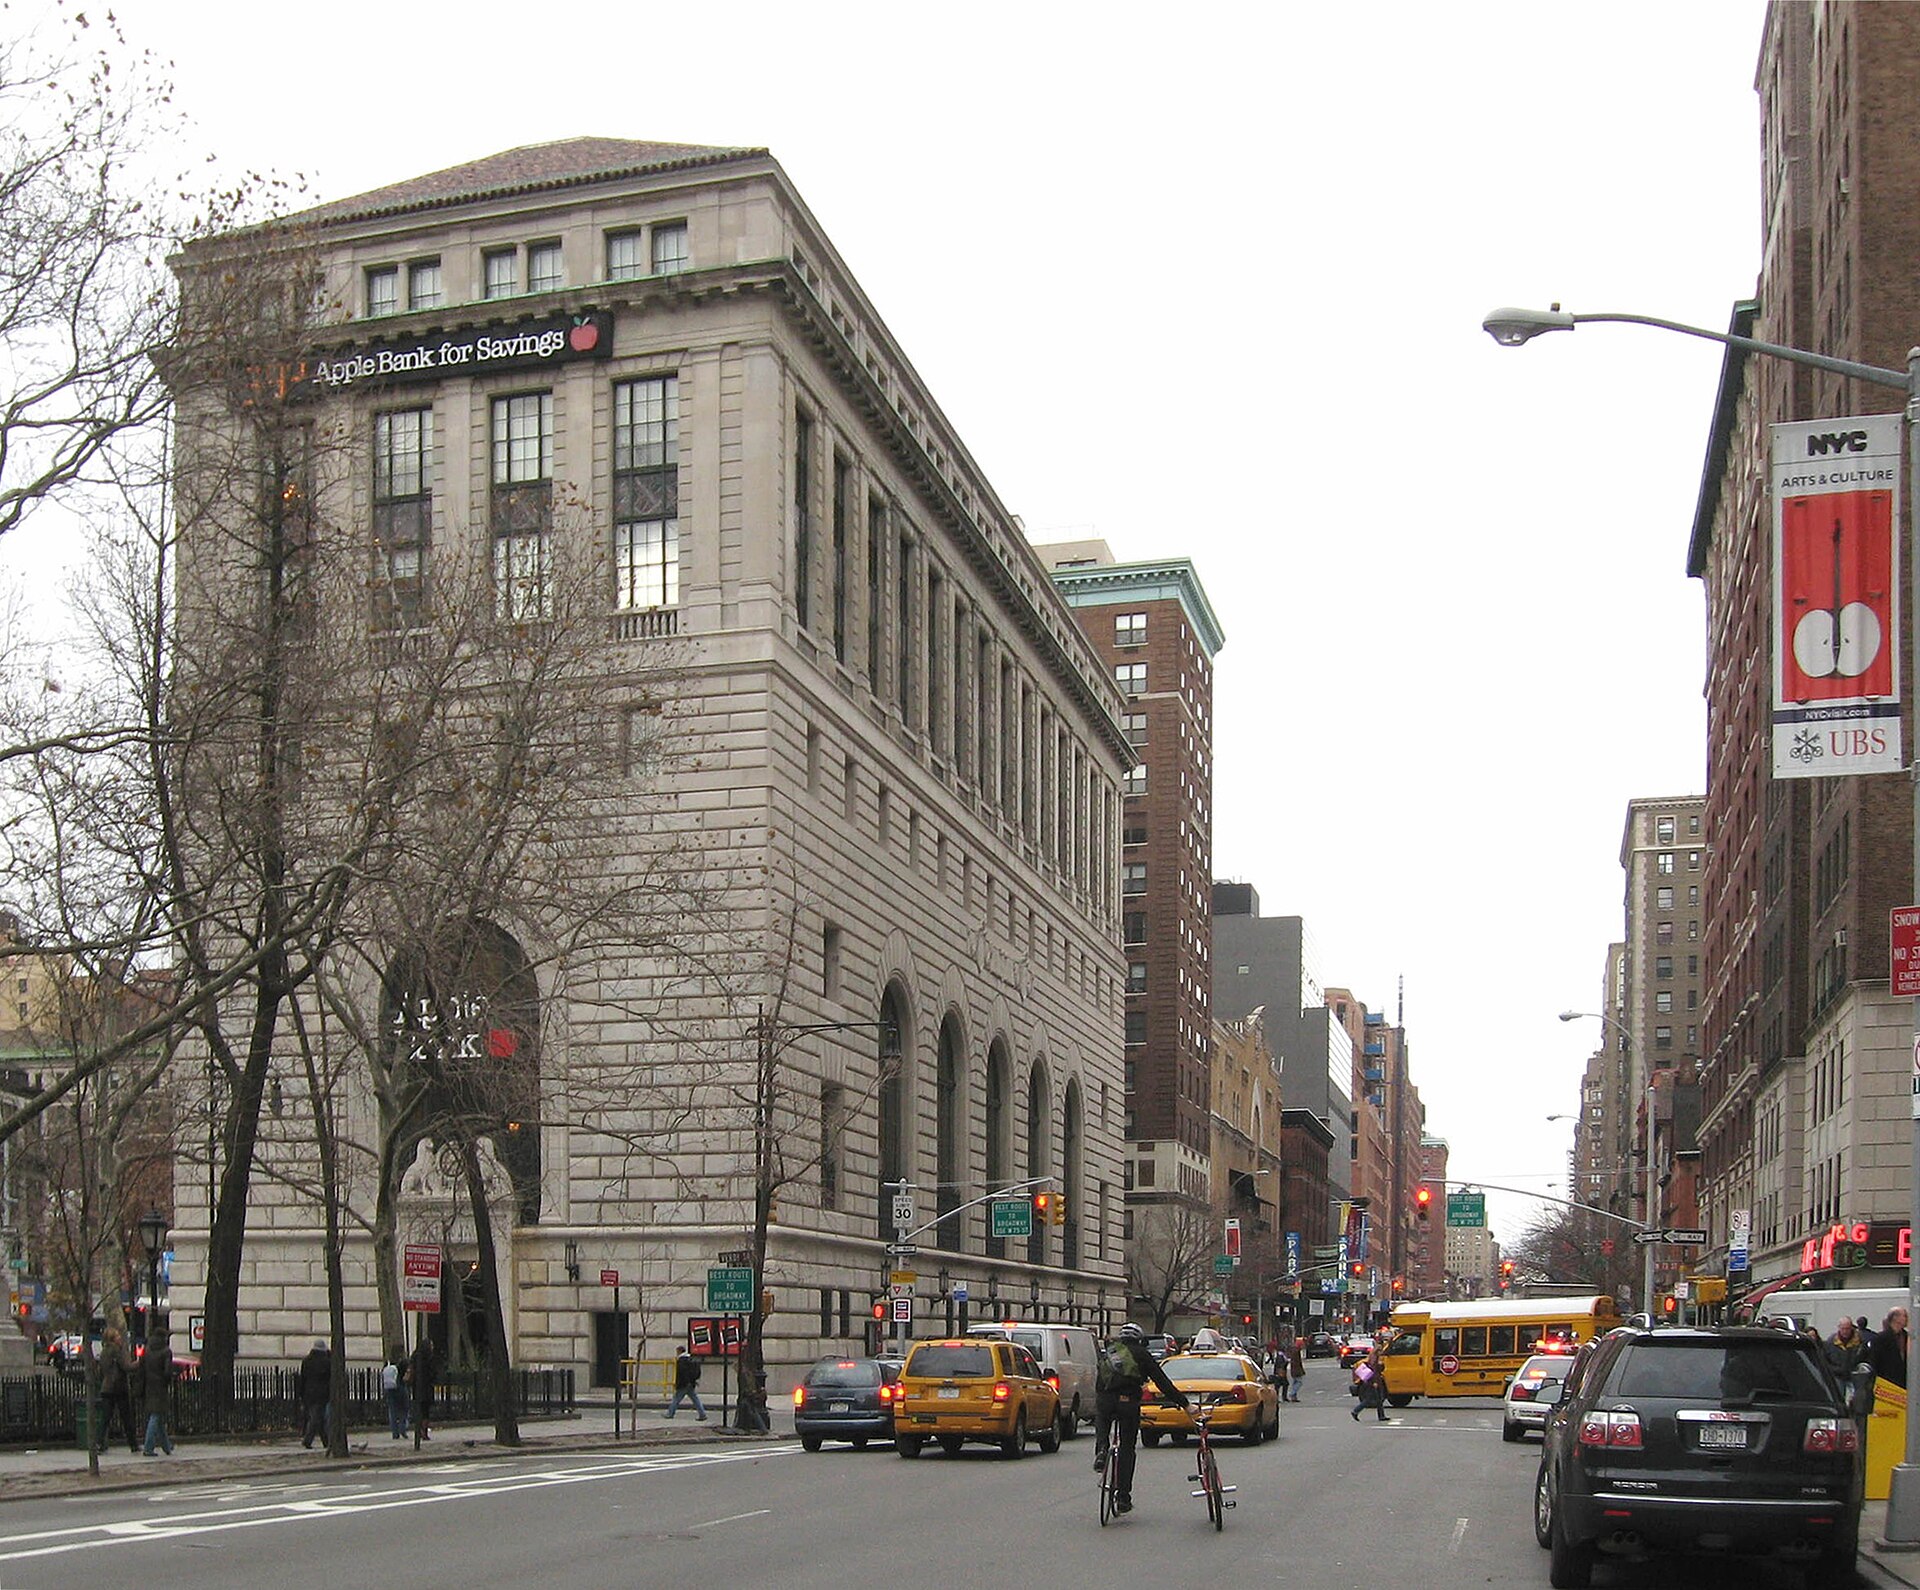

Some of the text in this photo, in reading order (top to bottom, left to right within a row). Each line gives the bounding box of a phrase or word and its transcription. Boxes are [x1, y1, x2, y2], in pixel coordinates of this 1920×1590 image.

[312, 357, 376, 387] Apple
[376, 346, 436, 372] Bank
[438, 342, 473, 367] for
[476, 331, 565, 362] Savings
[1807, 430, 1868, 456] NYC
[1781, 469, 1894, 488] ARTS & CULTURE
[1805, 707, 1870, 719] NYCvisit.com
[1829, 727, 1887, 757] UBS
[1894, 913, 1920, 927] SNOW
[1894, 947, 1906, 960] NO
[895, 1208, 911, 1219] 30
[1288, 1240, 1297, 1277] PARK
[1339, 1243, 1347, 1280] PARK
[709, 1271, 750, 1279] BEST ROUTE
[726, 1282, 735, 1290] TO
[714, 1292, 746, 1300] BROADWAY
[1709, 1412, 1740, 1421] GMC
